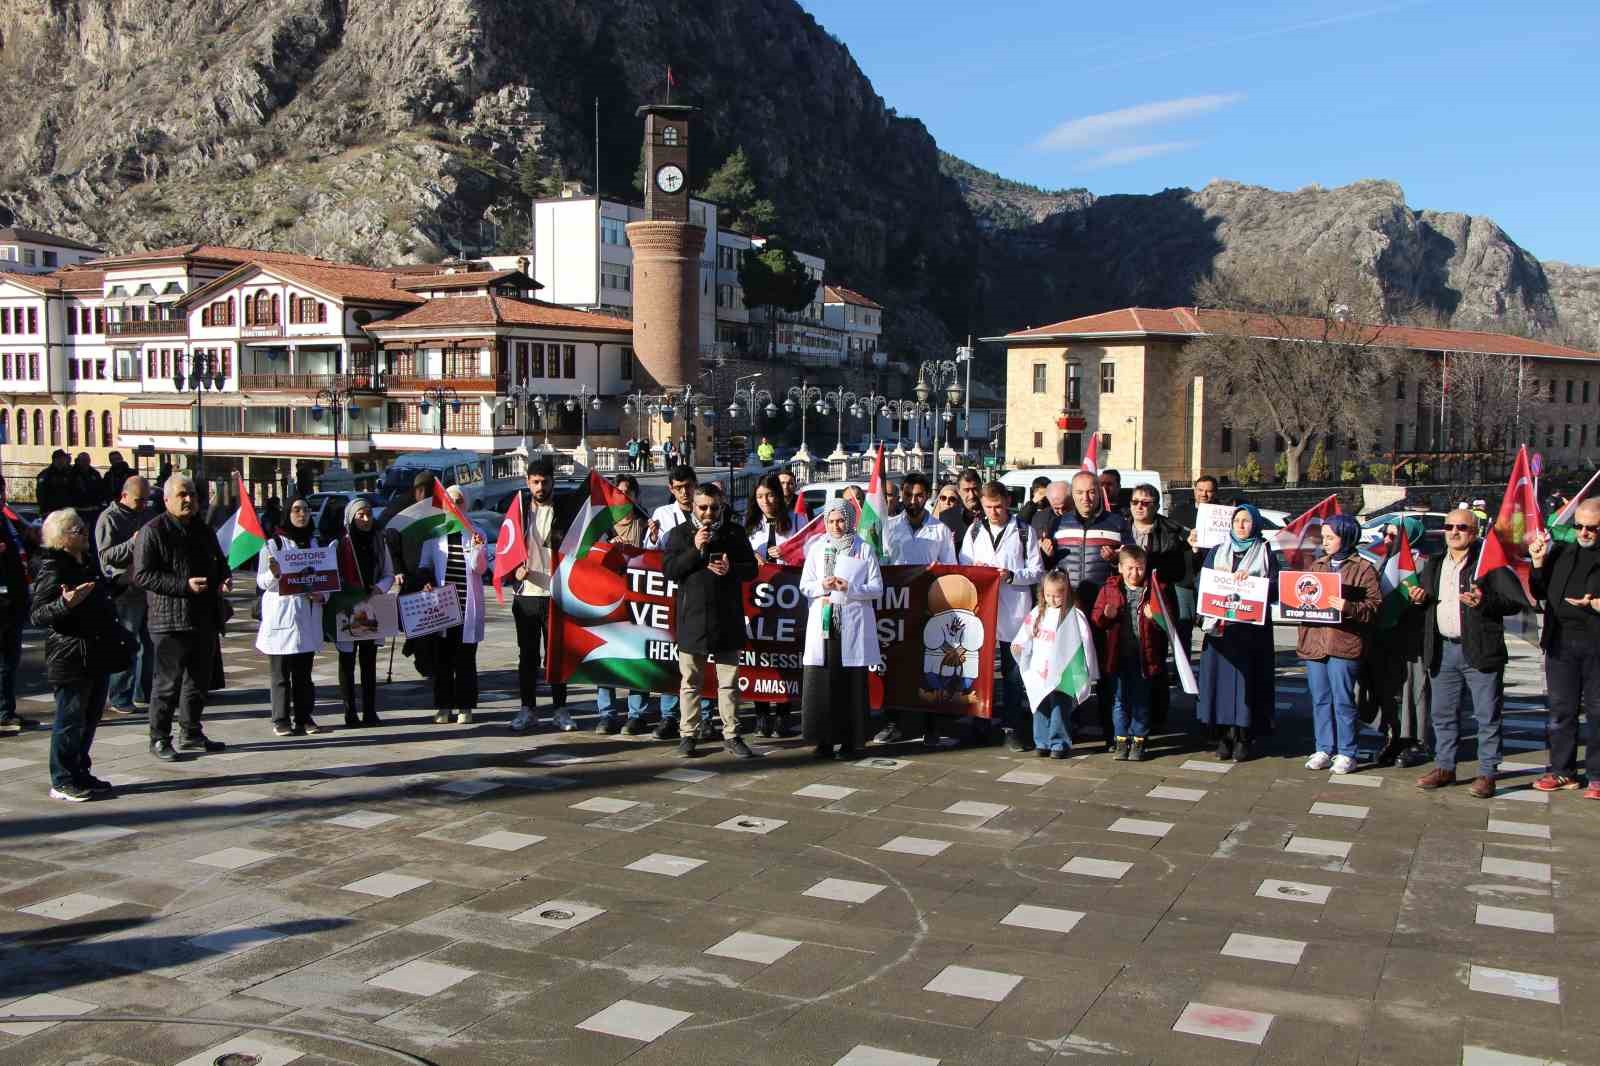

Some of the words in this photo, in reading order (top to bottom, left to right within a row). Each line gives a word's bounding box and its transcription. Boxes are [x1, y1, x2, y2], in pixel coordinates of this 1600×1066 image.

[285, 551, 327, 561] DOCTORS
[288, 575, 328, 585] PALESTINE
[1211, 599, 1253, 613] PALESTINE
[630, 602, 670, 629] VE
[754, 678, 799, 695] AMASYA
